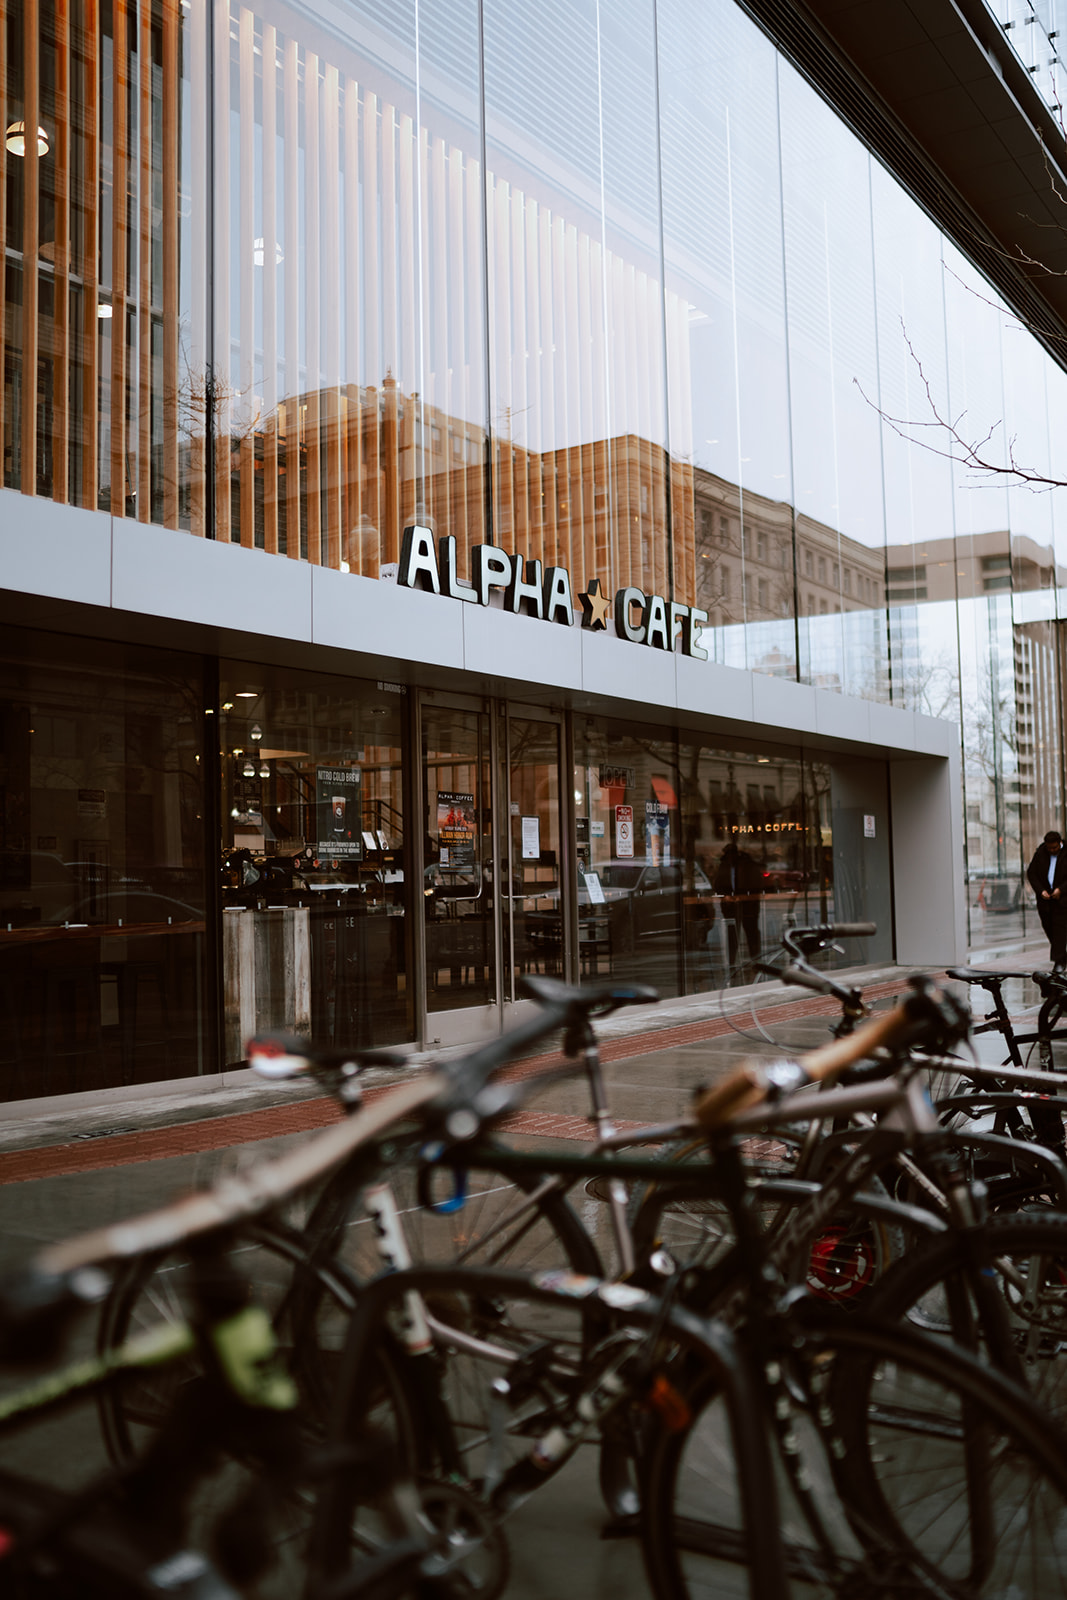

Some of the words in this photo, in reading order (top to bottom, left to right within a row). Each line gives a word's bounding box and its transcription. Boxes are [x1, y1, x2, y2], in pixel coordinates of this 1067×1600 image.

[398, 525, 574, 626] ALPHA
[616, 587, 709, 660] CAFE
[318, 770, 332, 781] NITRO
[333, 771, 345, 782] COLD
[346, 772, 360, 783] BREW
[605, 766, 634, 787] OPEN
